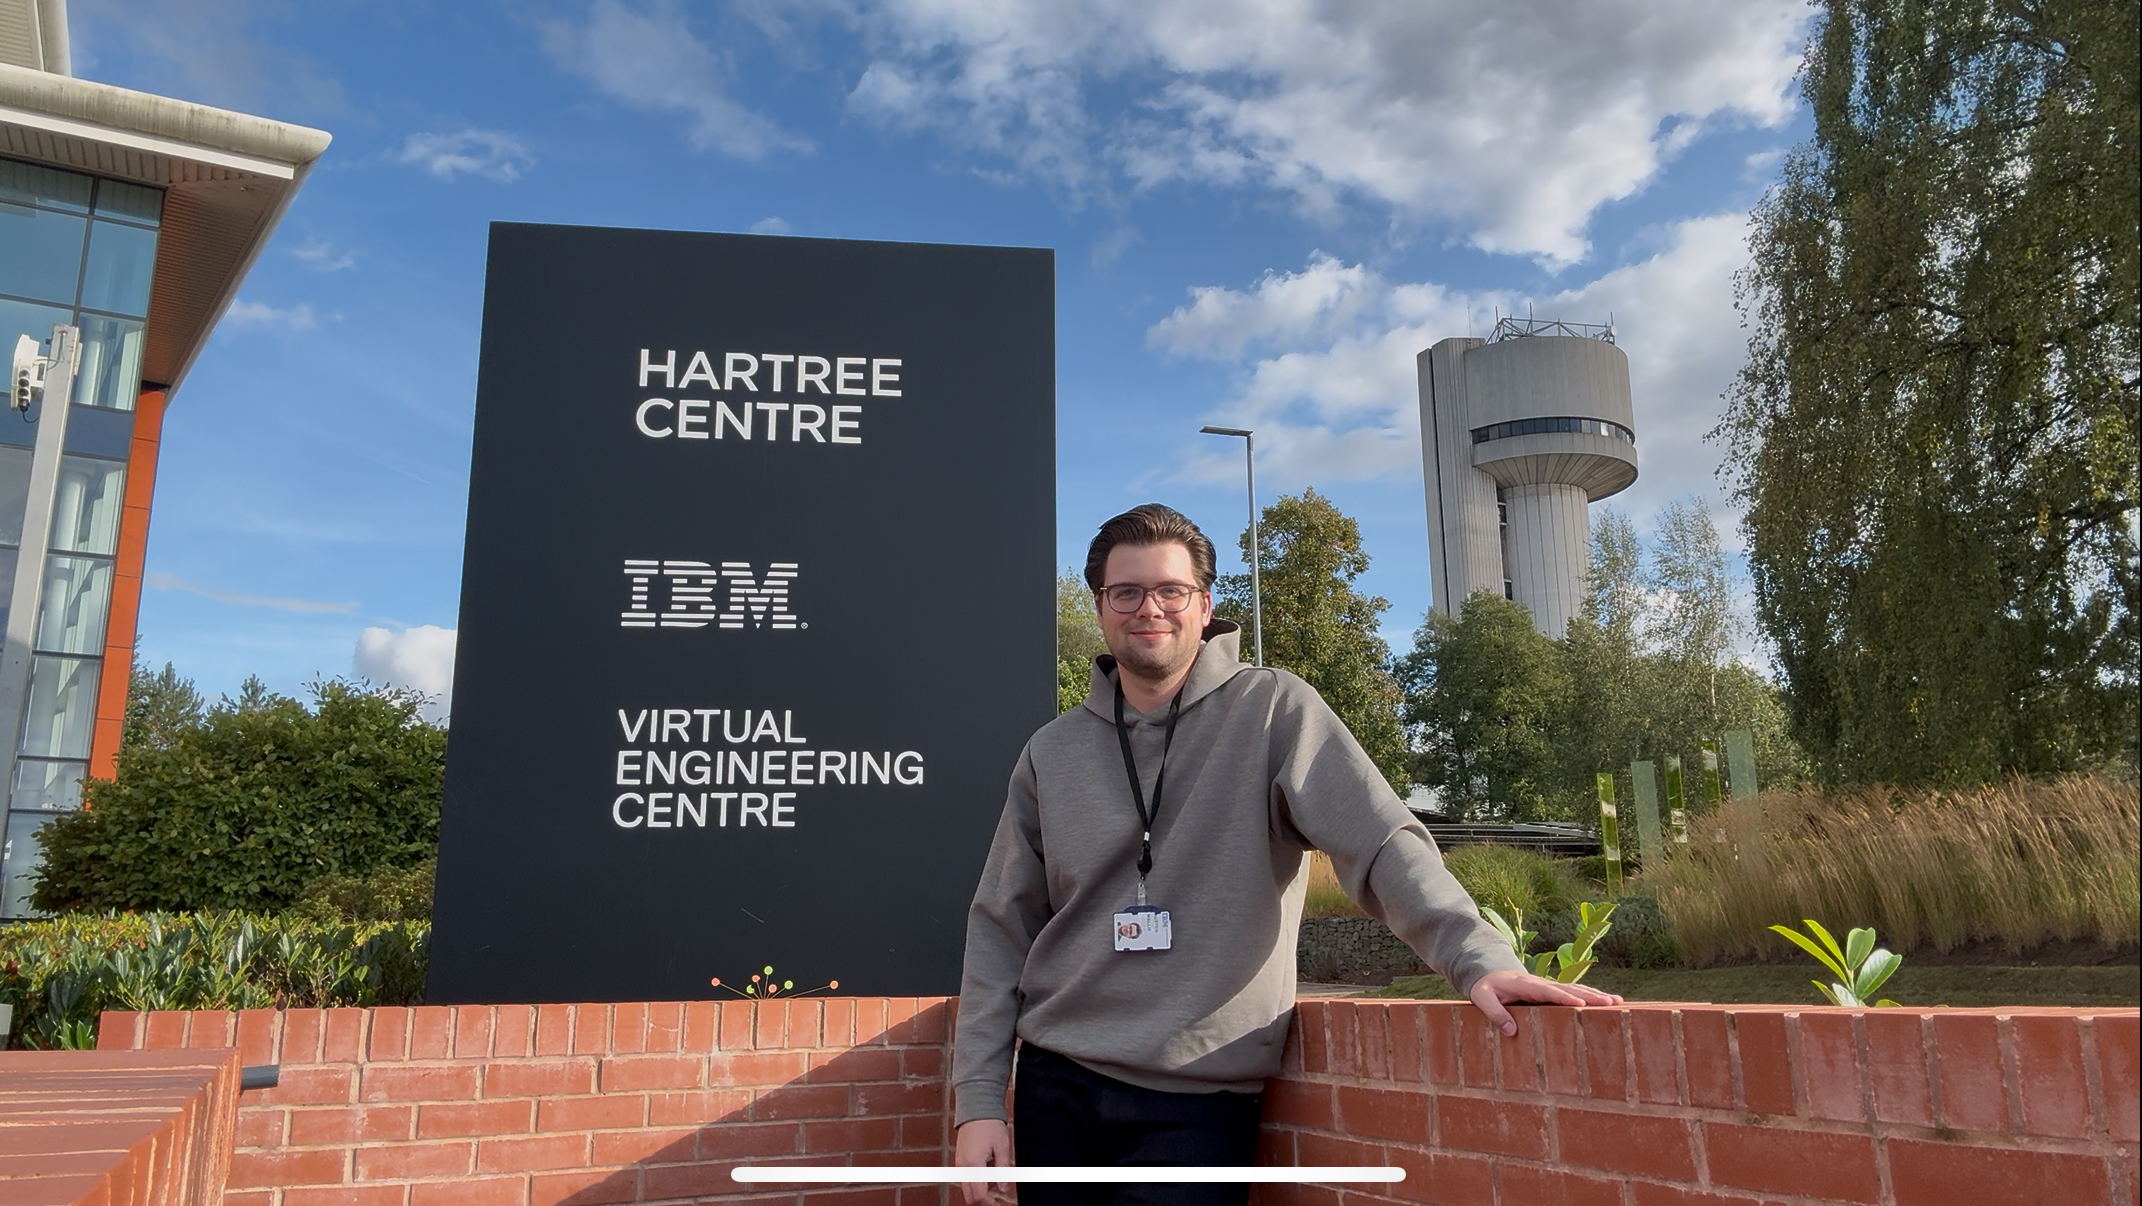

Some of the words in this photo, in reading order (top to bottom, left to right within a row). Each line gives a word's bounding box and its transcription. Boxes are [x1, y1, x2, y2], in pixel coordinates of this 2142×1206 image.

[638, 348, 902, 397] HARTREE
[635, 397, 863, 444] CENTRE
[620, 559, 799, 630] IBM
[618, 708, 807, 744] VIRTUAL
[616, 750, 924, 786] ENGINEERING
[612, 792, 797, 829] CENTRE
